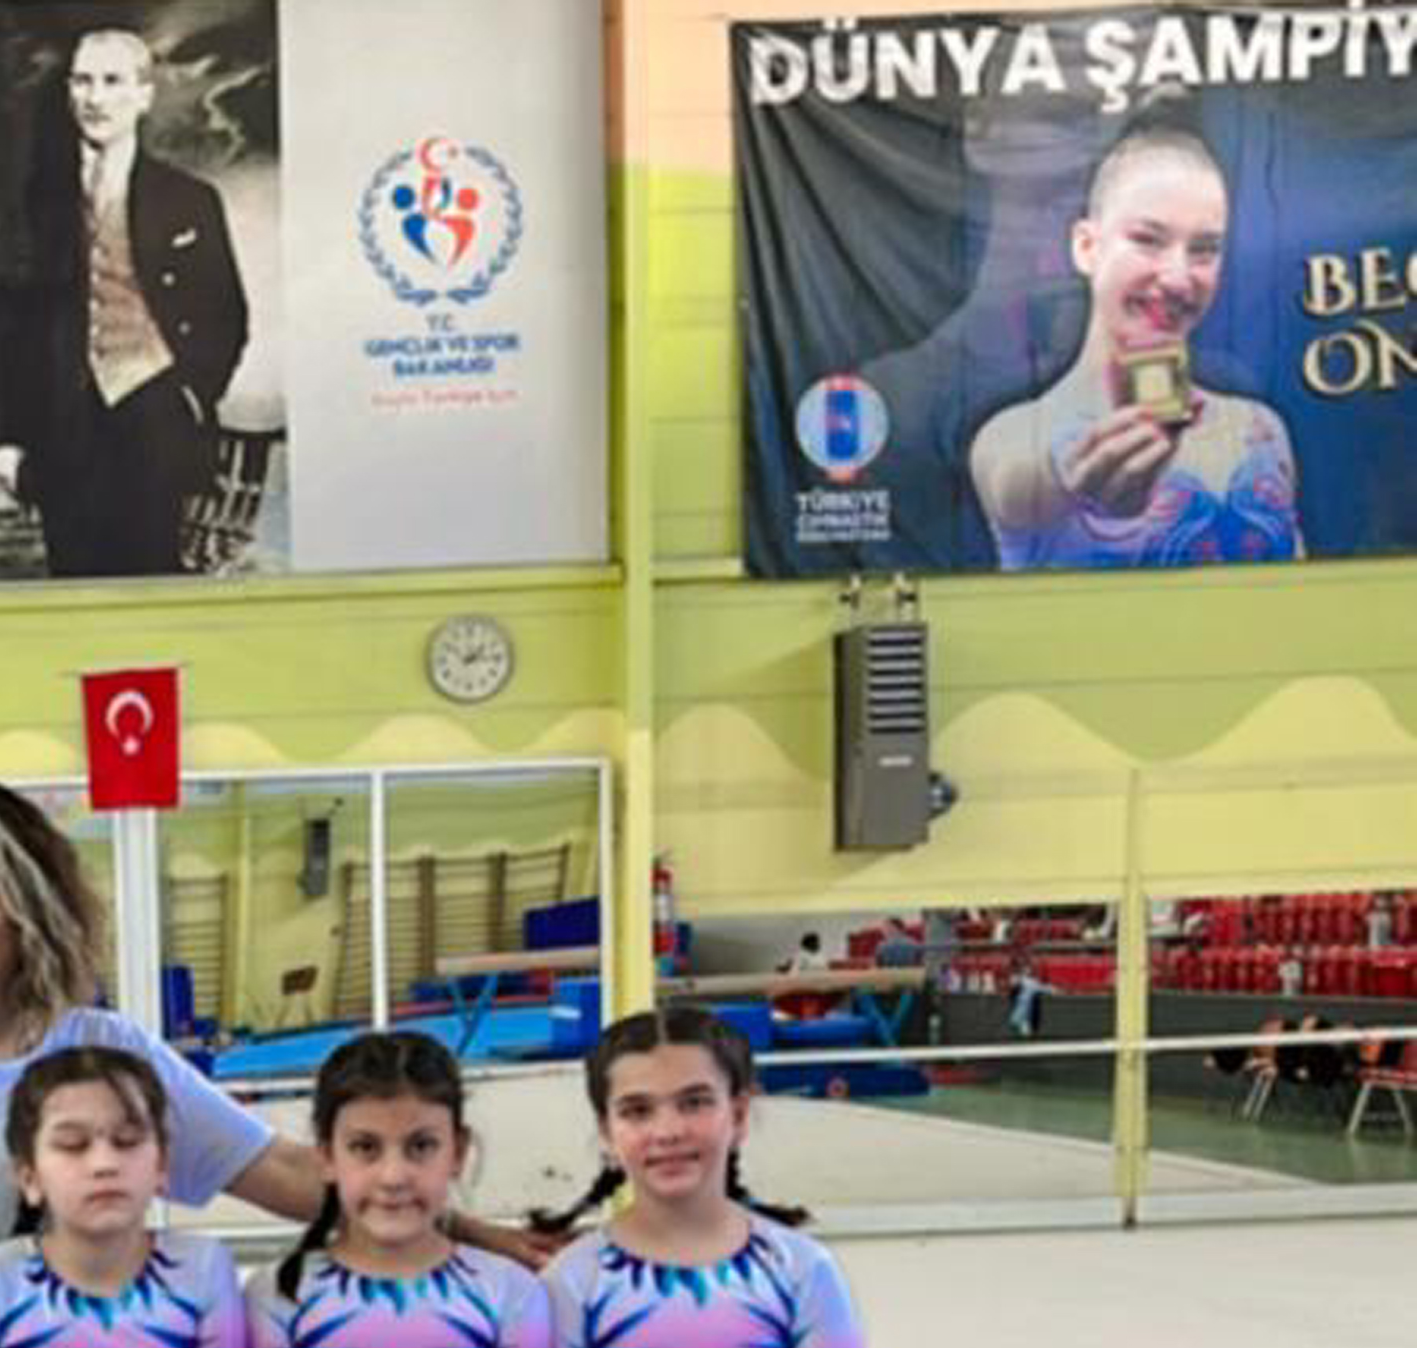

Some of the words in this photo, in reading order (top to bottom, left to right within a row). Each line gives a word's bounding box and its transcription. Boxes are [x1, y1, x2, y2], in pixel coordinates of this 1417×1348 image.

[749, 17, 1068, 103] DÜNYA
[1084, 0, 1417, 113] ŞAMPİY
[1304, 247, 1417, 317] BE
[472, 332, 520, 352] SPOR
[795, 486, 890, 513] TÜRKİYE
